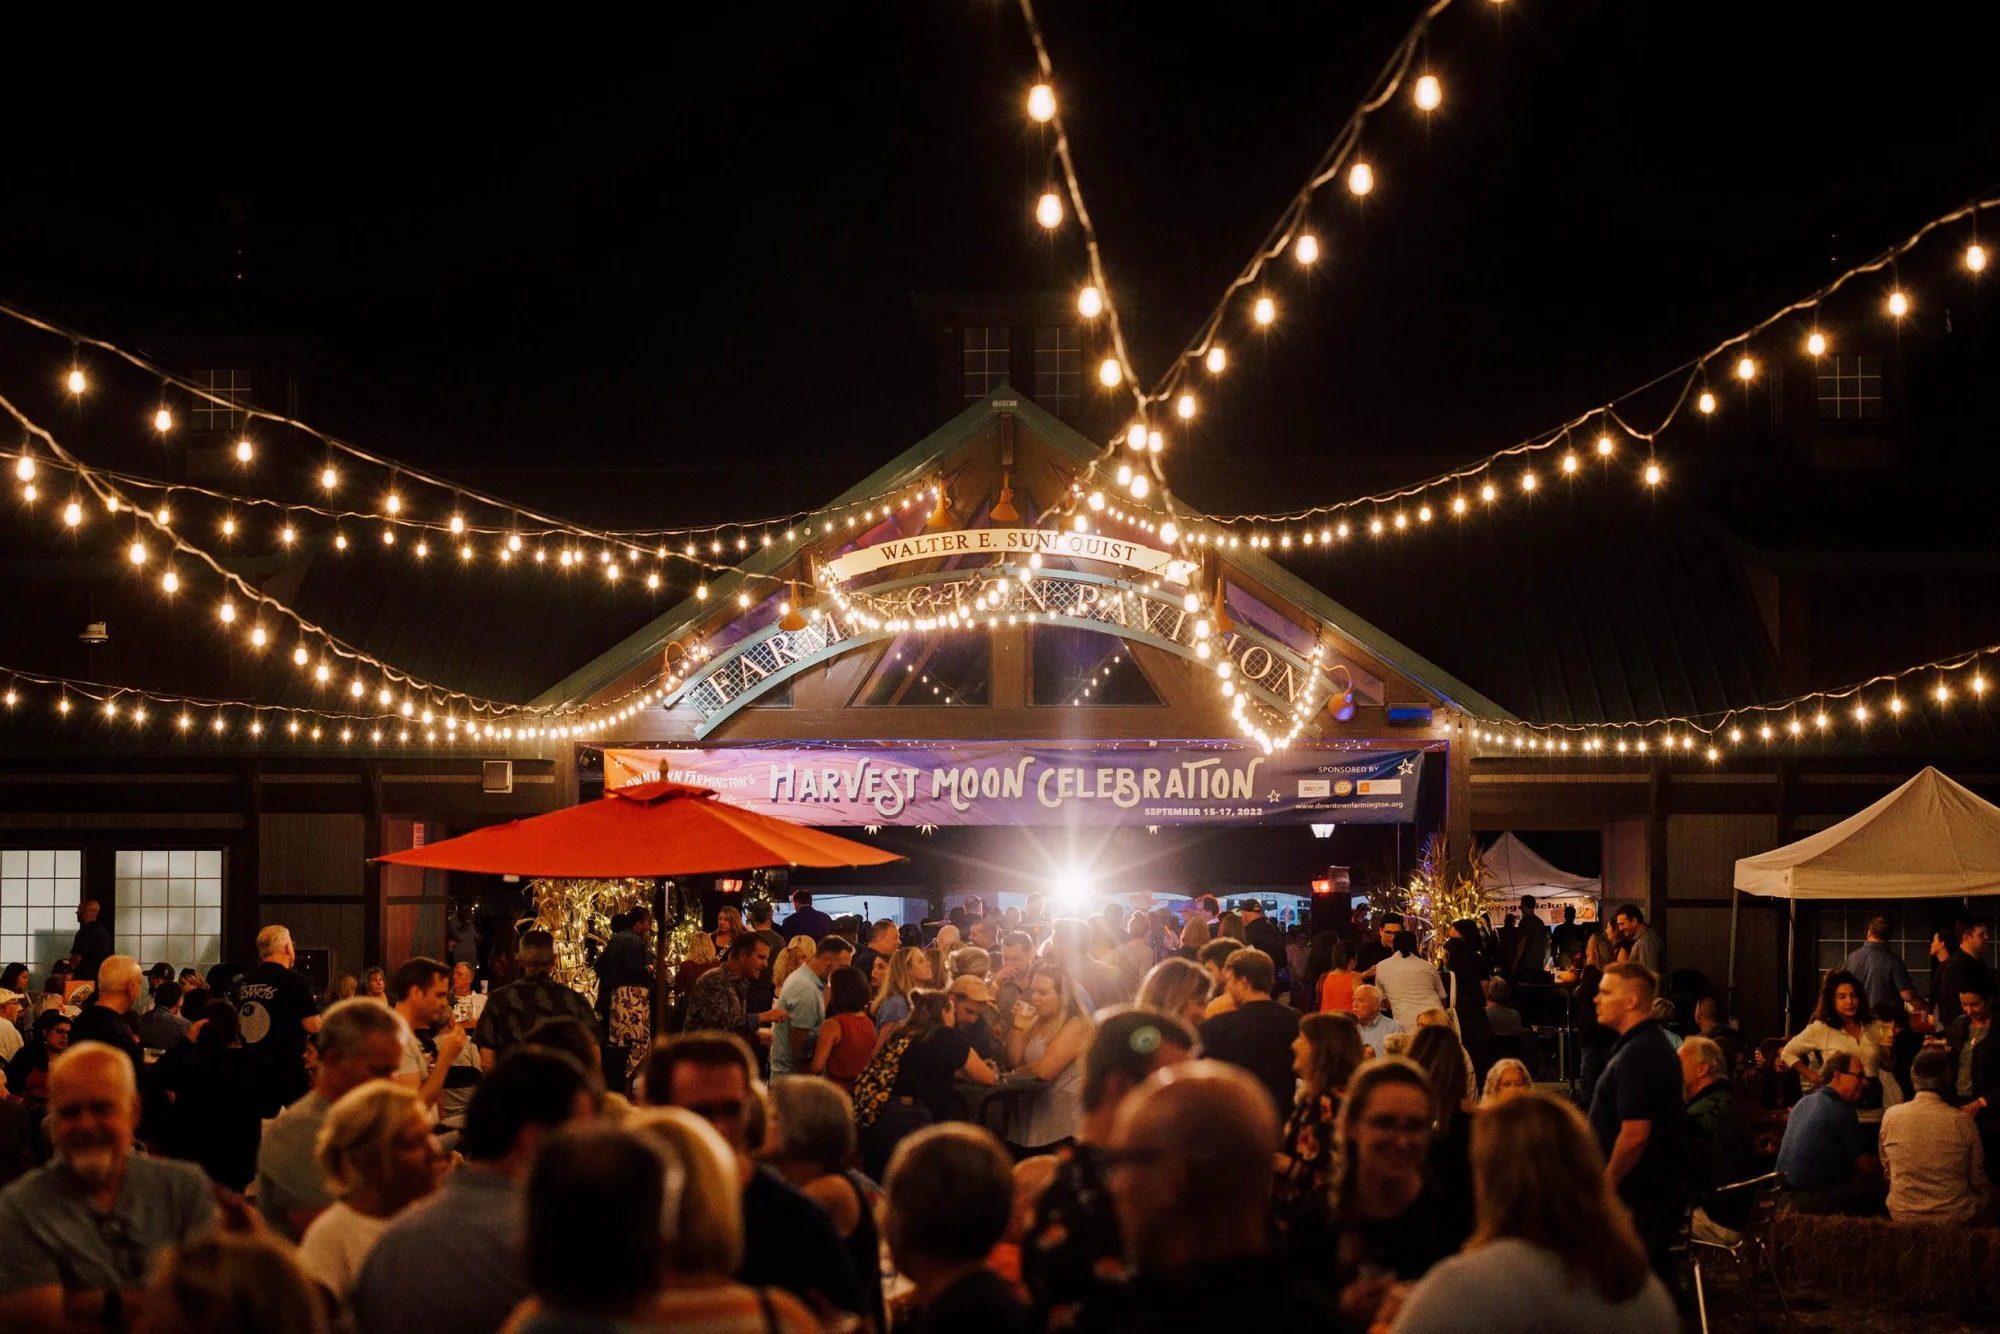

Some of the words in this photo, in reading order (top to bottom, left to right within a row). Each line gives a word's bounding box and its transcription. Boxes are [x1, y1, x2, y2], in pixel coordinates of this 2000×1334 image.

[880, 534, 967, 561] WALTER
[979, 532, 998, 548] E.
[1007, 532, 1137, 562] SUNQUIST
[1067, 584, 1308, 704] PAVIION
[685, 770, 756, 788] FARMINGTON'S
[1318, 766, 1367, 774] SPONSORED
[769, 757, 920, 817] HARVEST
[932, 757, 1035, 811] MOON
[1037, 757, 1265, 808] CELEBRATION
[1144, 807, 1201, 816] SEPTEMBER
[1203, 807, 1235, 817] 15-17,
[1237, 807, 1263, 816] 2022
[1295, 801, 1404, 810] www.downtownfarmington.org
